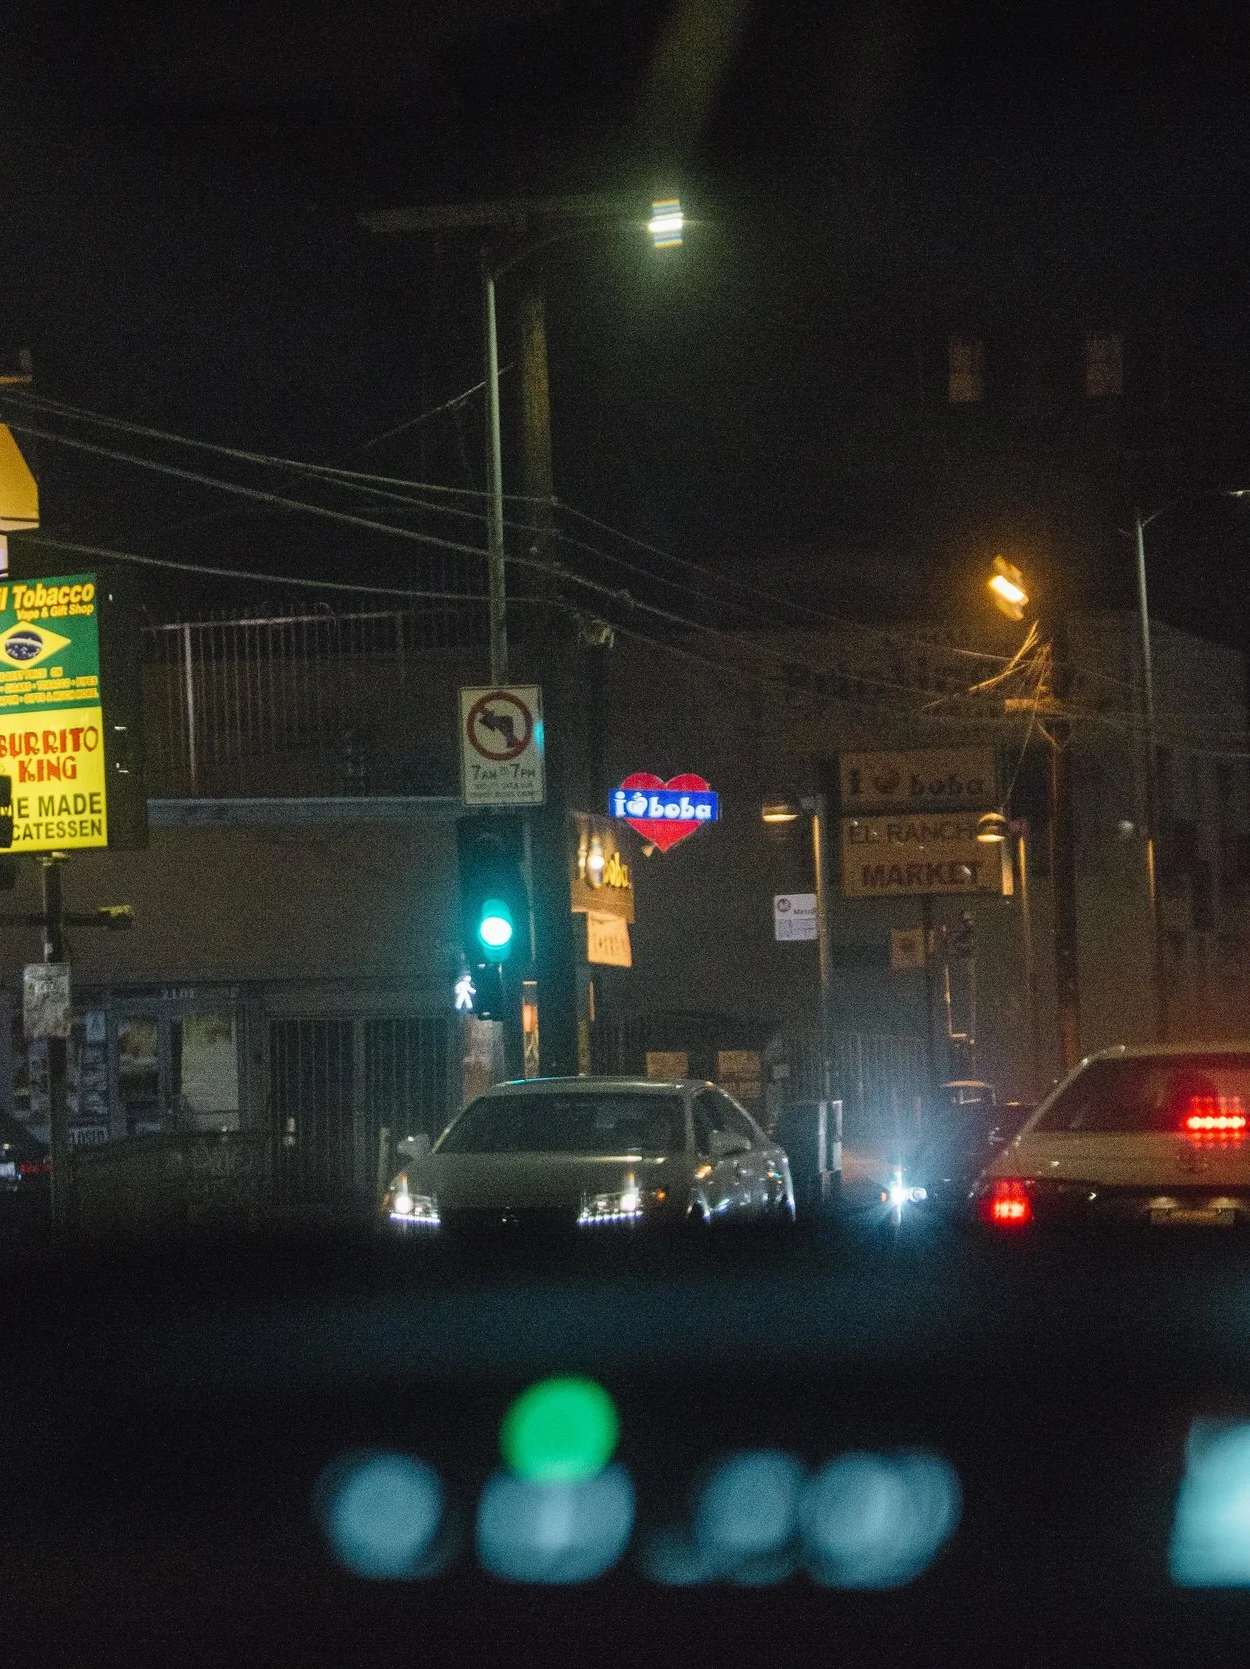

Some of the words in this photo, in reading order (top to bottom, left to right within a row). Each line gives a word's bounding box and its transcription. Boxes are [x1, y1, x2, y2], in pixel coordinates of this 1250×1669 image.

[12, 582, 95, 609] Tobacco
[41, 606, 49, 618] &
[50, 604, 67, 617] Gift
[69, 603, 94, 616] Shop
[18, 756, 77, 783] KING
[910, 773, 984, 795] boba
[38, 792, 102, 817] MADE
[649, 795, 712, 819] boba
[862, 860, 981, 887] MARKET
